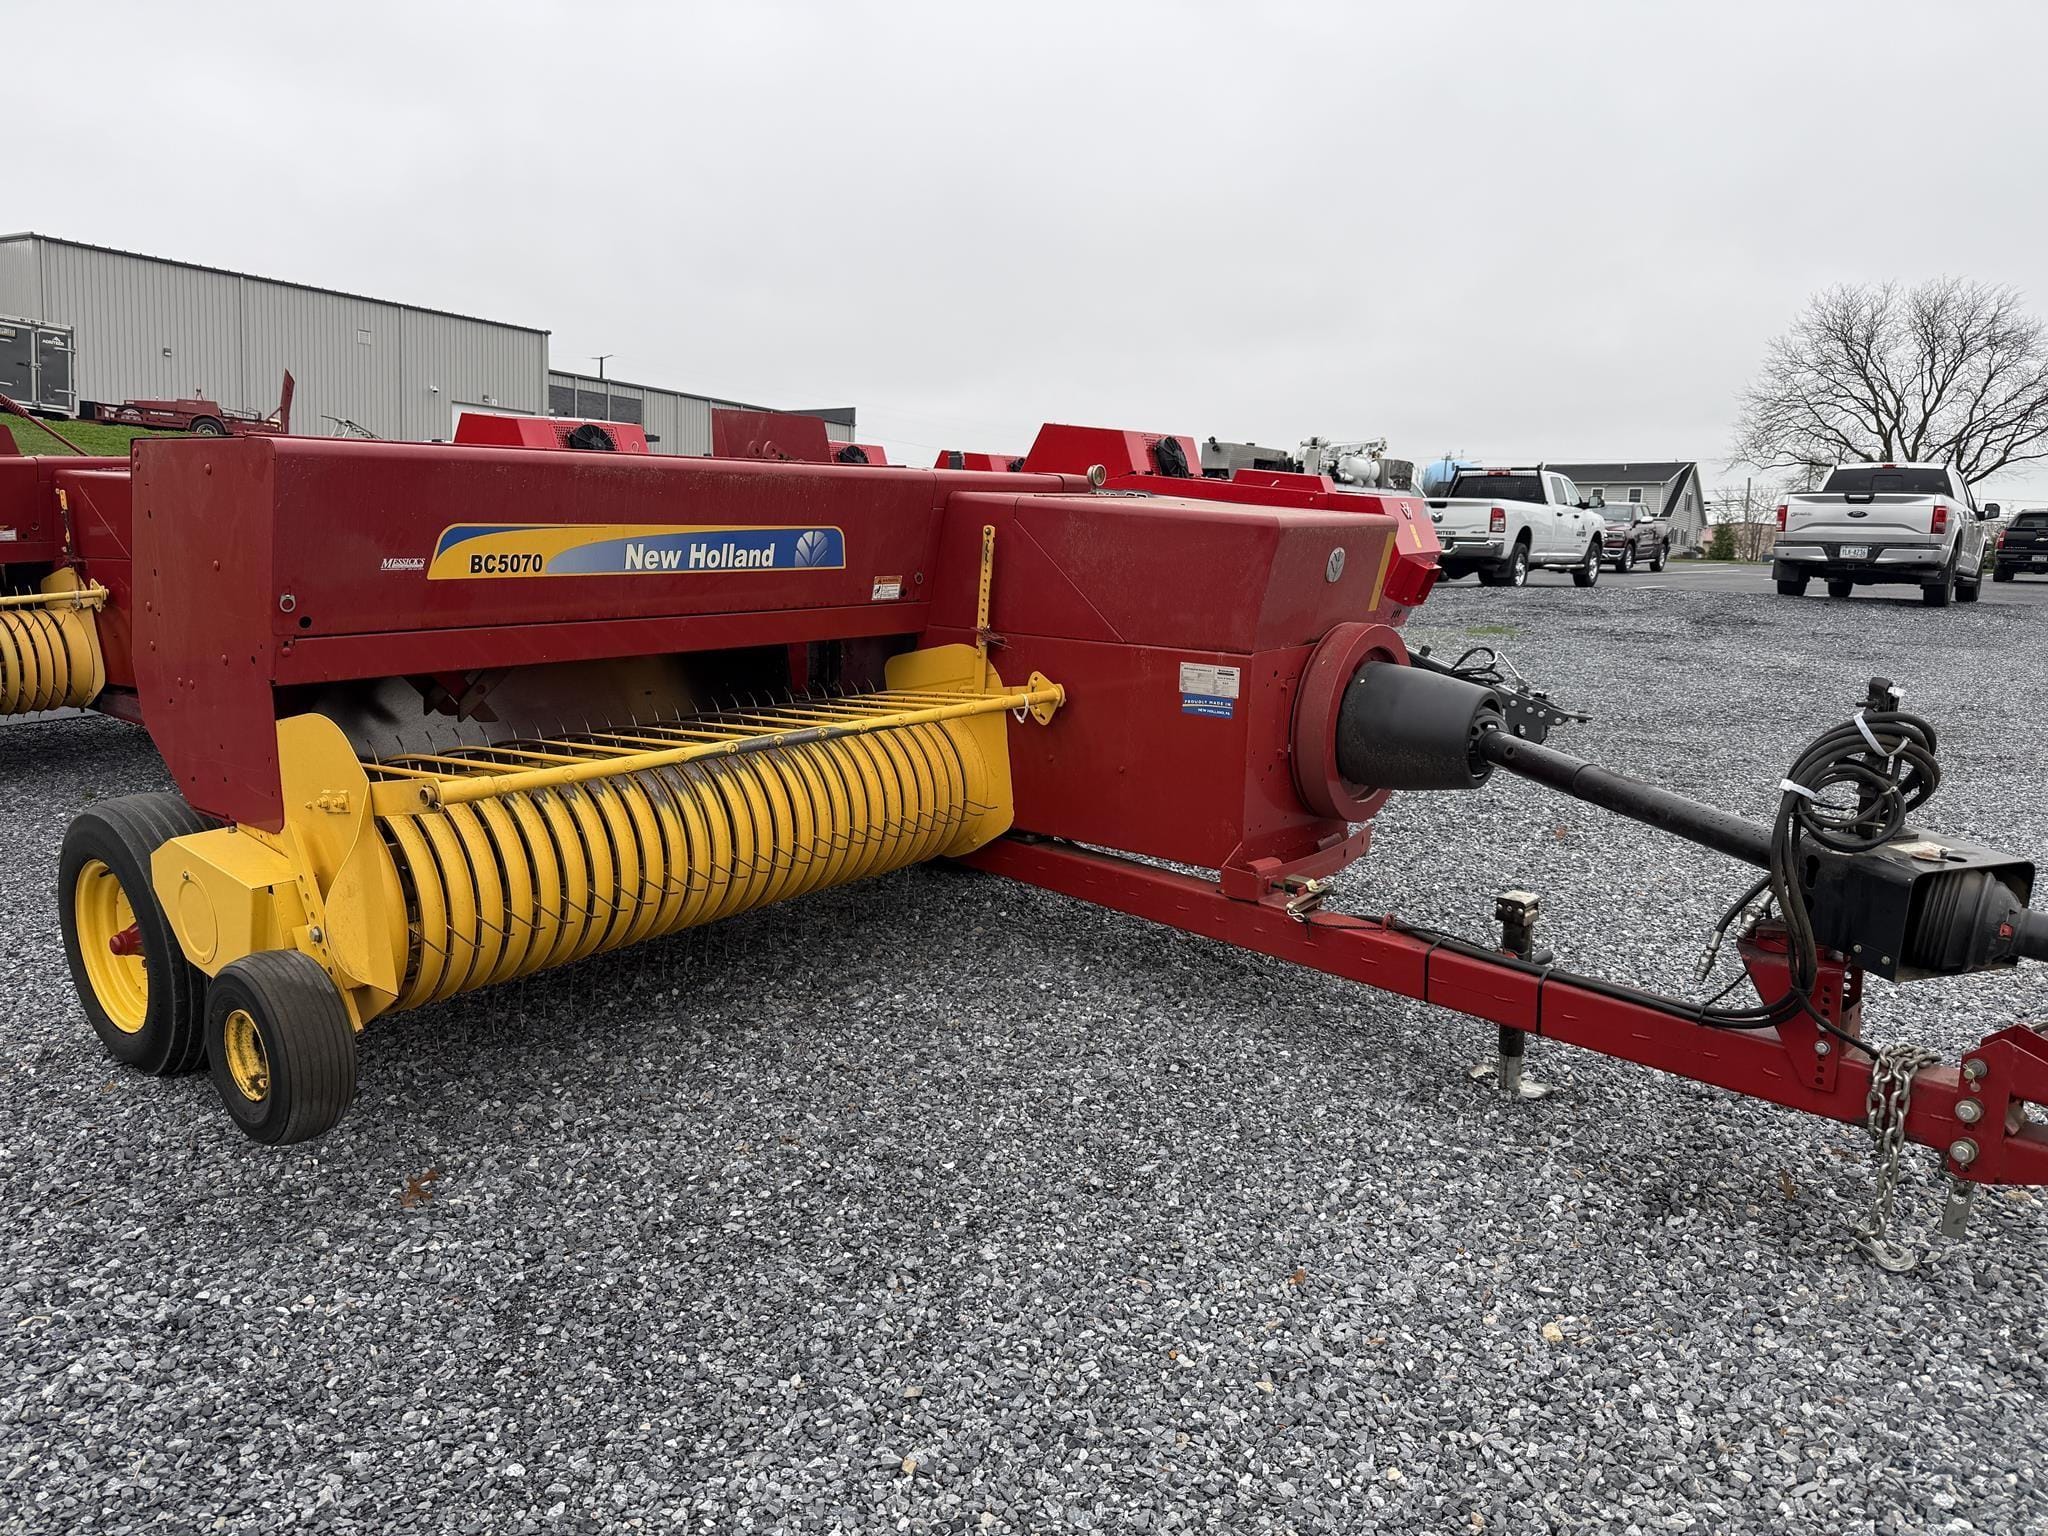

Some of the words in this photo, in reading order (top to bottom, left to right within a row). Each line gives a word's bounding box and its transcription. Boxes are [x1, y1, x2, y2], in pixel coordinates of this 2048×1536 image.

[470, 554, 543, 573] BC5070
[624, 543, 682, 570] New
[688, 542, 775, 569] Holland
